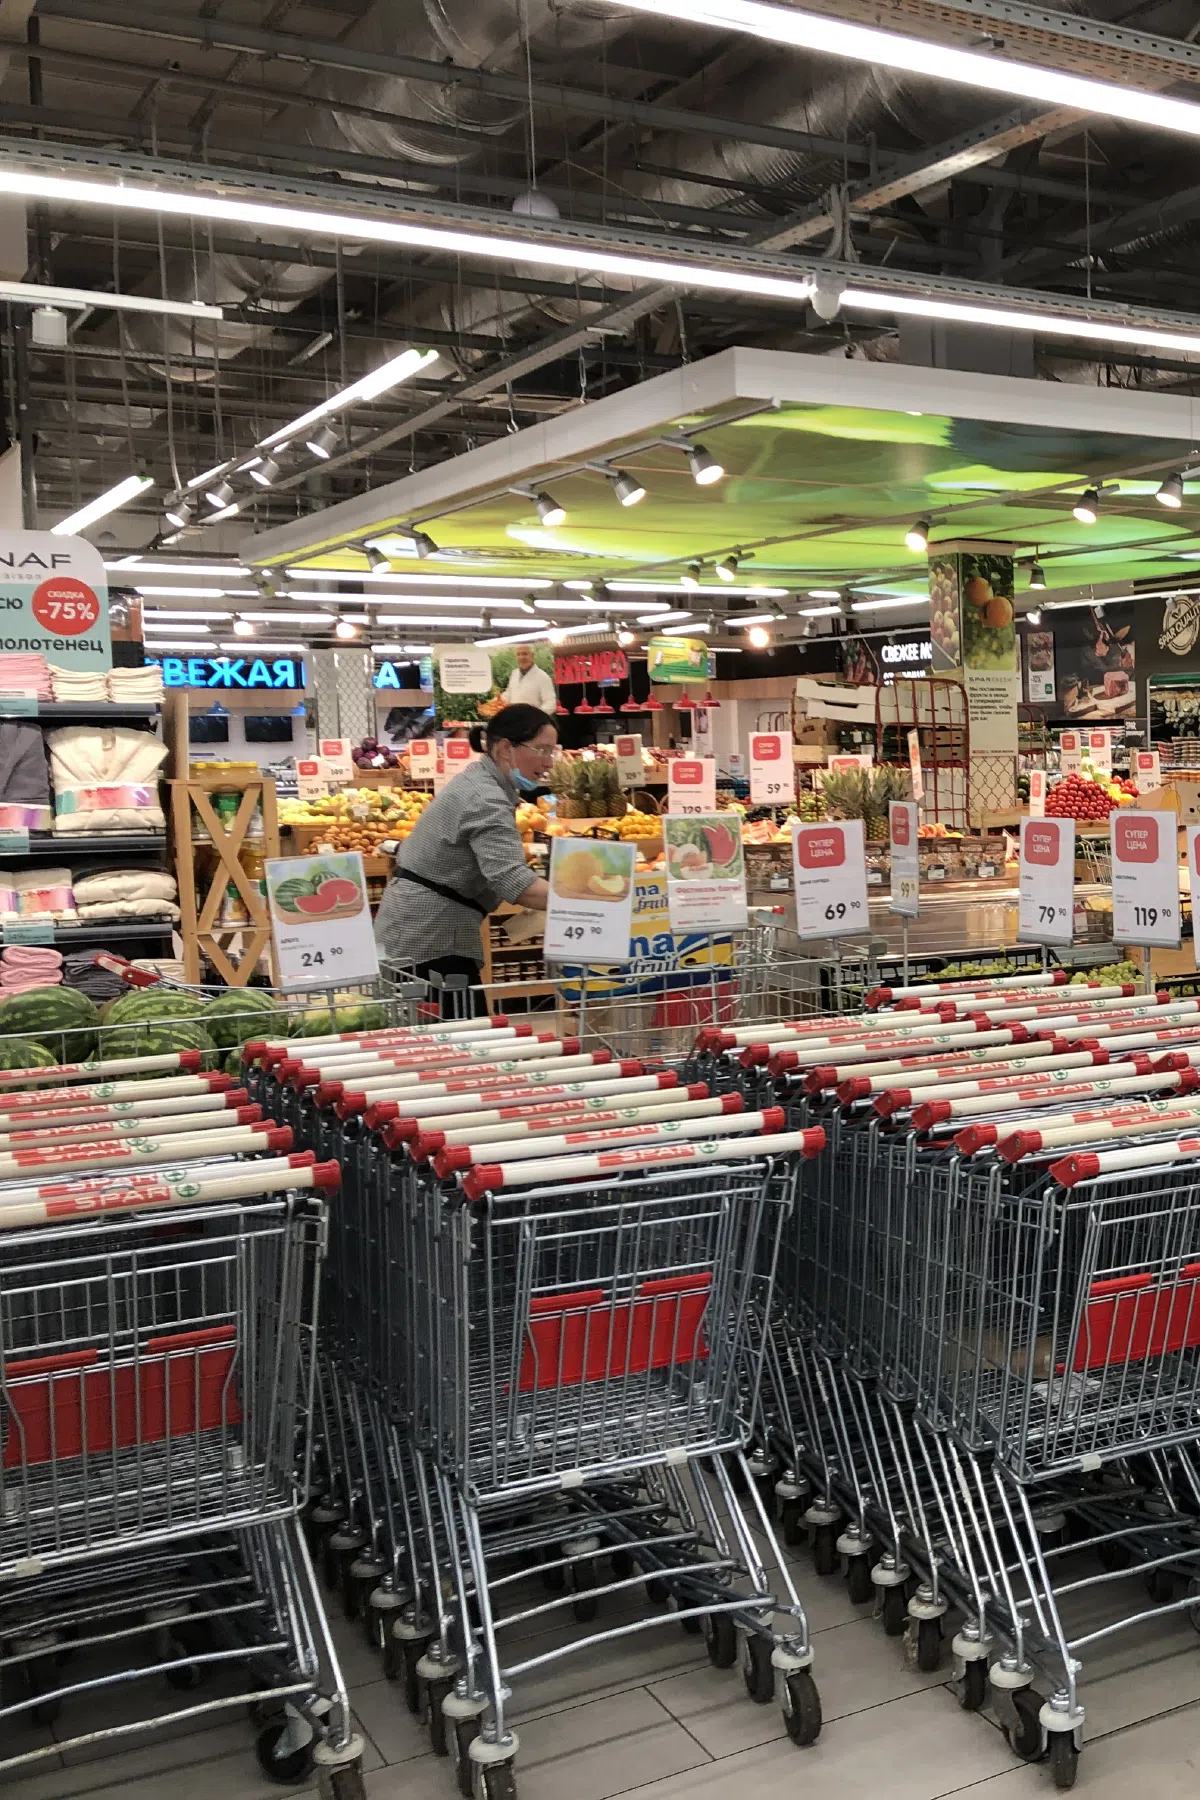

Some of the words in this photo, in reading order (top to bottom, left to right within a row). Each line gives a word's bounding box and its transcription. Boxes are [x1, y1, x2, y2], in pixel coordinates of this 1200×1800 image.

[47, 590, 84, 599] СКИДКА
[38, 601, 95, 620] -75%
[1158, 628, 1176, 650] SPAR
[882, 643, 919, 662] СВЕЖЕЕ
[145, 657, 295, 687] ВЕЖАЯ
[767, 783, 780, 794] 59
[1032, 835, 1052, 843] СУПЕР
[1125, 830, 1148, 839] СУПЕР
[809, 839, 835, 848] СУПЕР
[1033, 845, 1050, 854] ЦЕНА
[1127, 840, 1147, 850] ЦЕНА
[811, 849, 834, 857] ЦЕНА
[901, 883, 910, 898] 99
[825, 903, 846, 920] 69
[1039, 906, 1055, 924] 79
[1059, 908, 1066, 916] 90
[1134, 907, 1157, 926] 119
[1162, 909, 1171, 917] 90
[564, 926, 584, 940] 49
[301, 951, 325, 967] 24
[330, 947, 343, 955] 90
[994, 1072, 1051, 1086] SPAR
[620, 1144, 695, 1161] SPAR
[75, 1186, 170, 1209] SPAR
